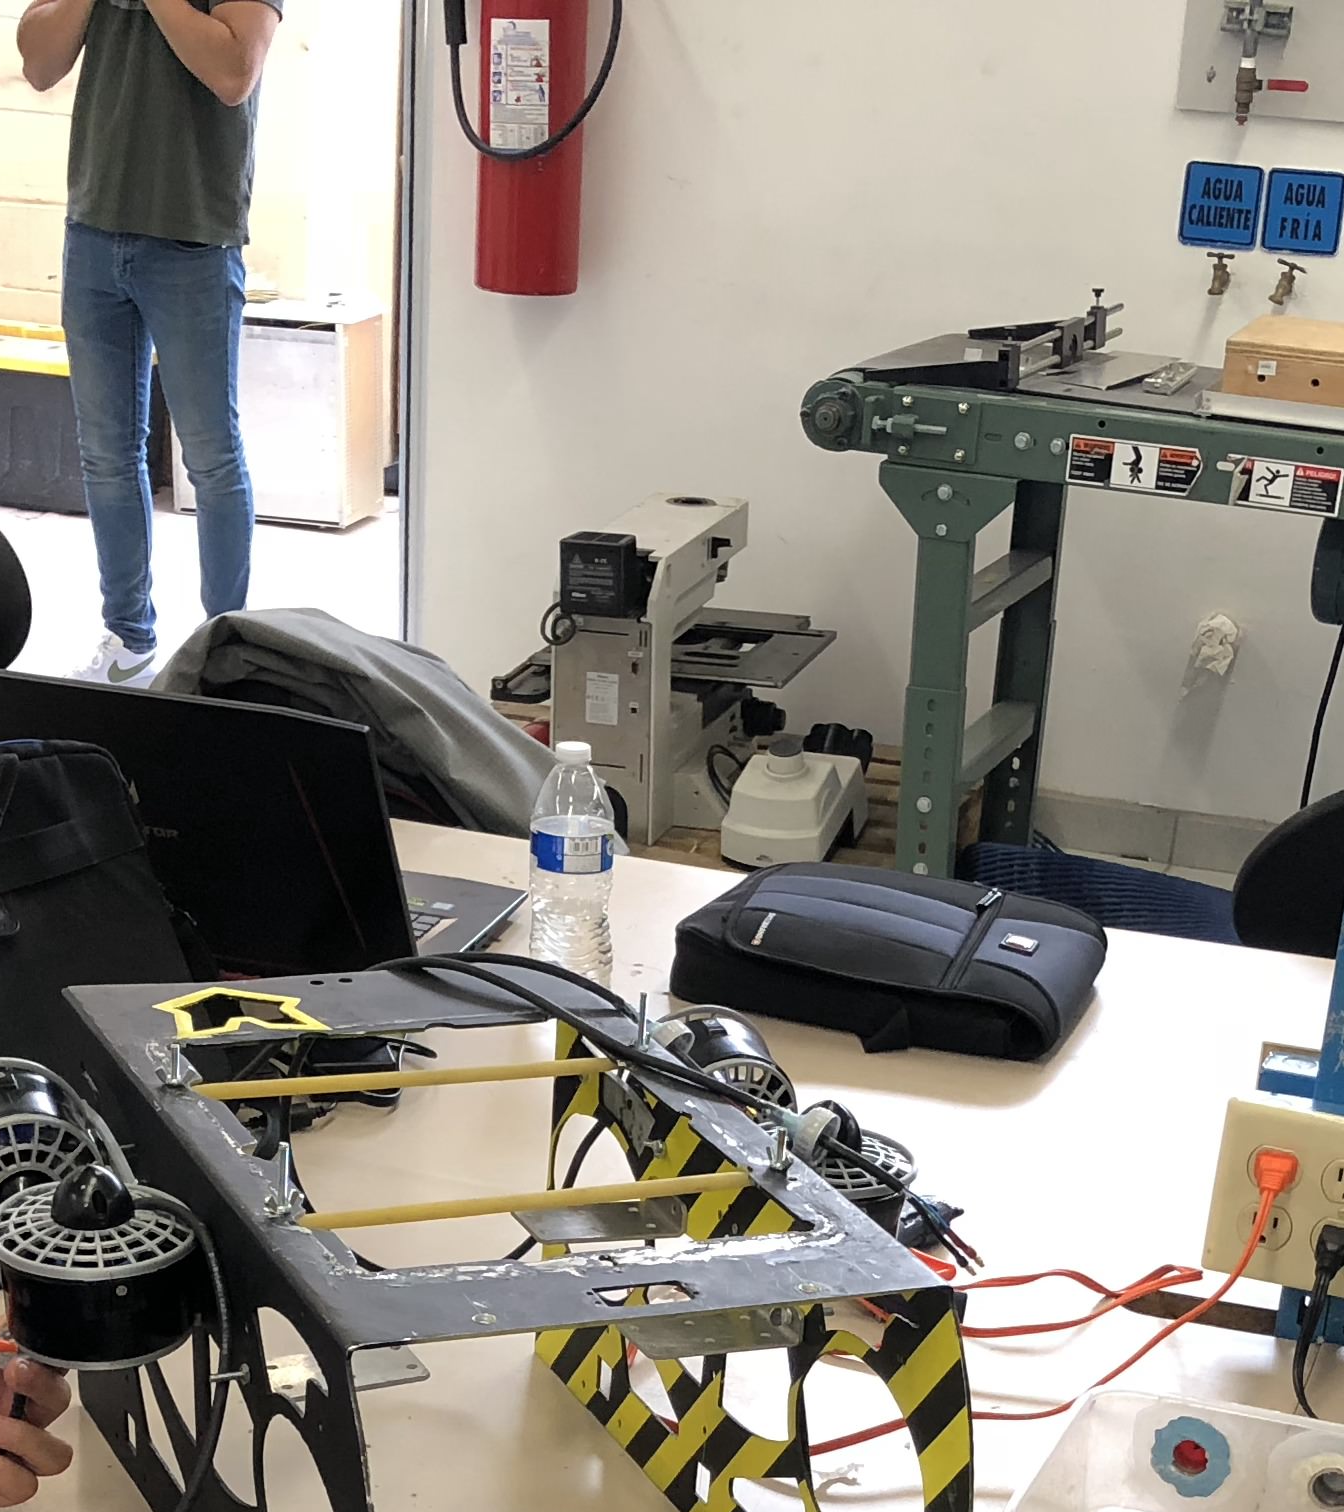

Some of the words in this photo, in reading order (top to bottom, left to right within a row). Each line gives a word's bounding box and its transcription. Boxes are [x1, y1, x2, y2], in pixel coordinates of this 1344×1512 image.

[1201, 176, 1244, 203] AGUA
[1283, 182, 1327, 209] AGUA
[1188, 203, 1252, 231] CALIENTE
[1278, 212, 1323, 242] FRÍA
